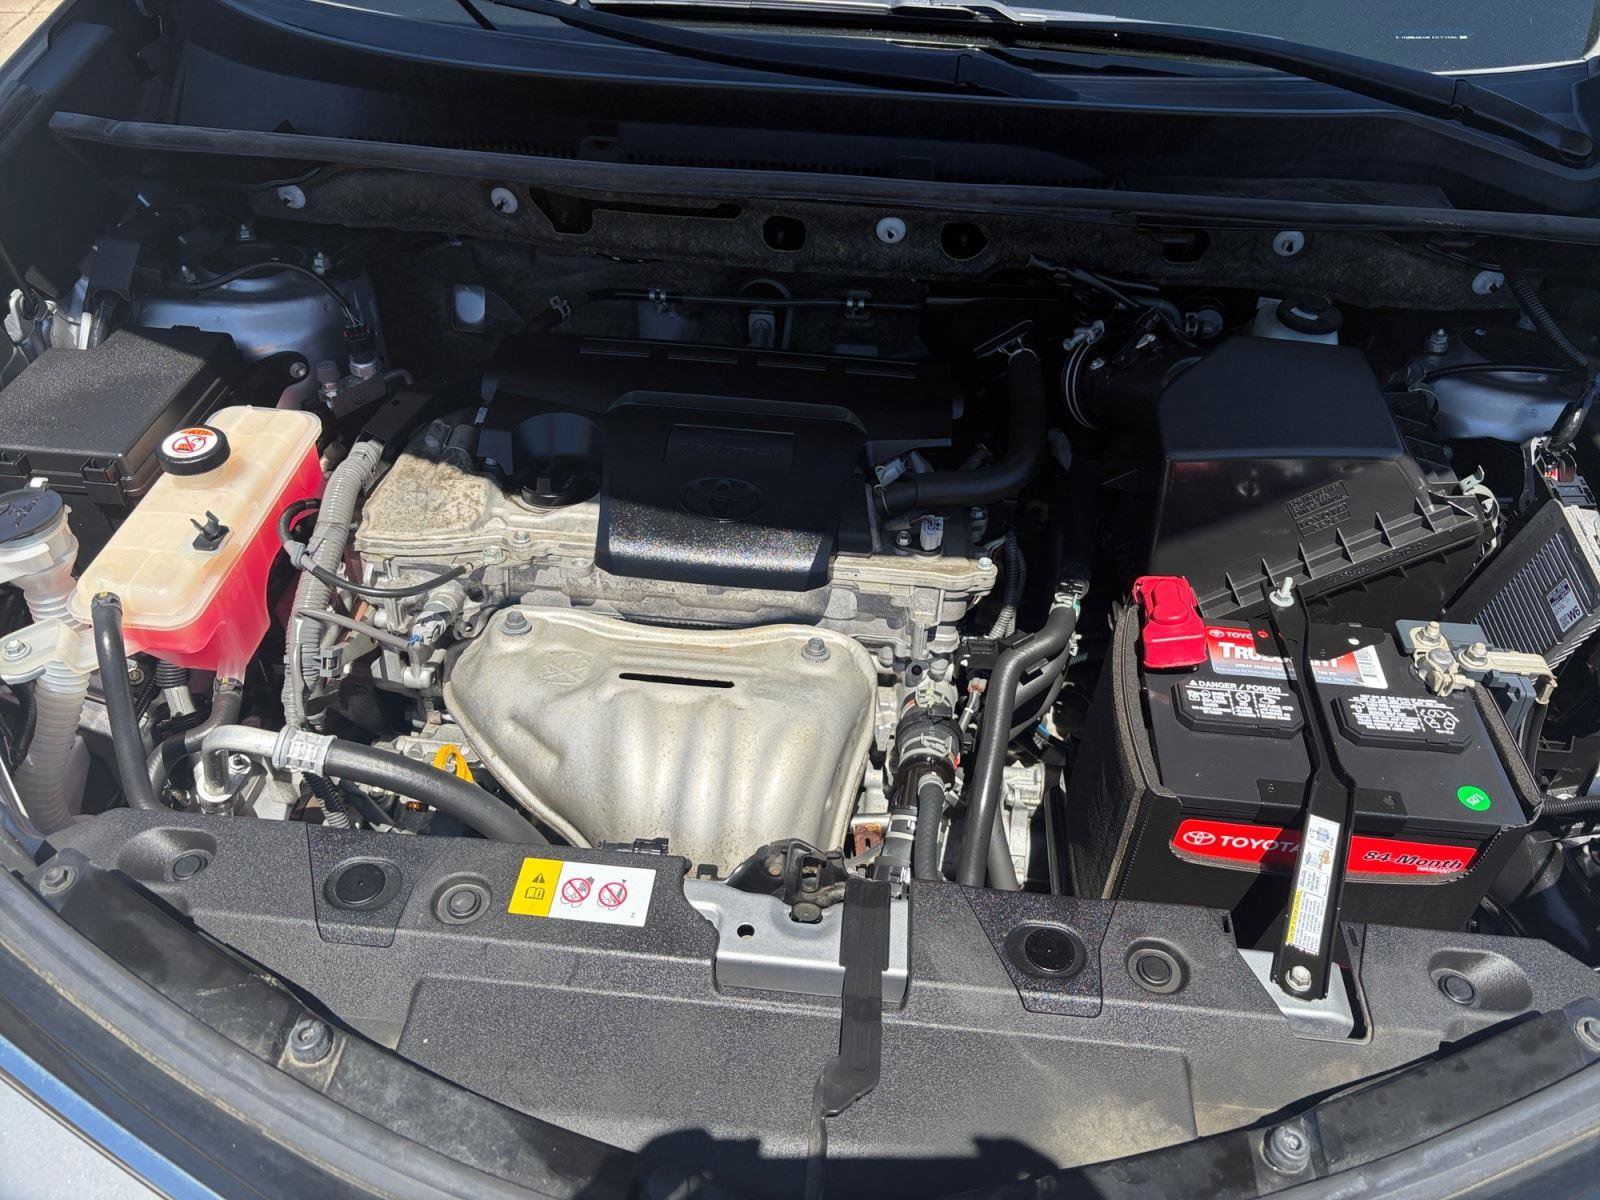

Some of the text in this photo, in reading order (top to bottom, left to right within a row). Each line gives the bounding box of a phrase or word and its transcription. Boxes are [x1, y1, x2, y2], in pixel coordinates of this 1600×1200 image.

[1198, 680, 1237, 690] DANGER
[1246, 684, 1281, 694] POISON
[1363, 850, 1463, 869] 84-Month
